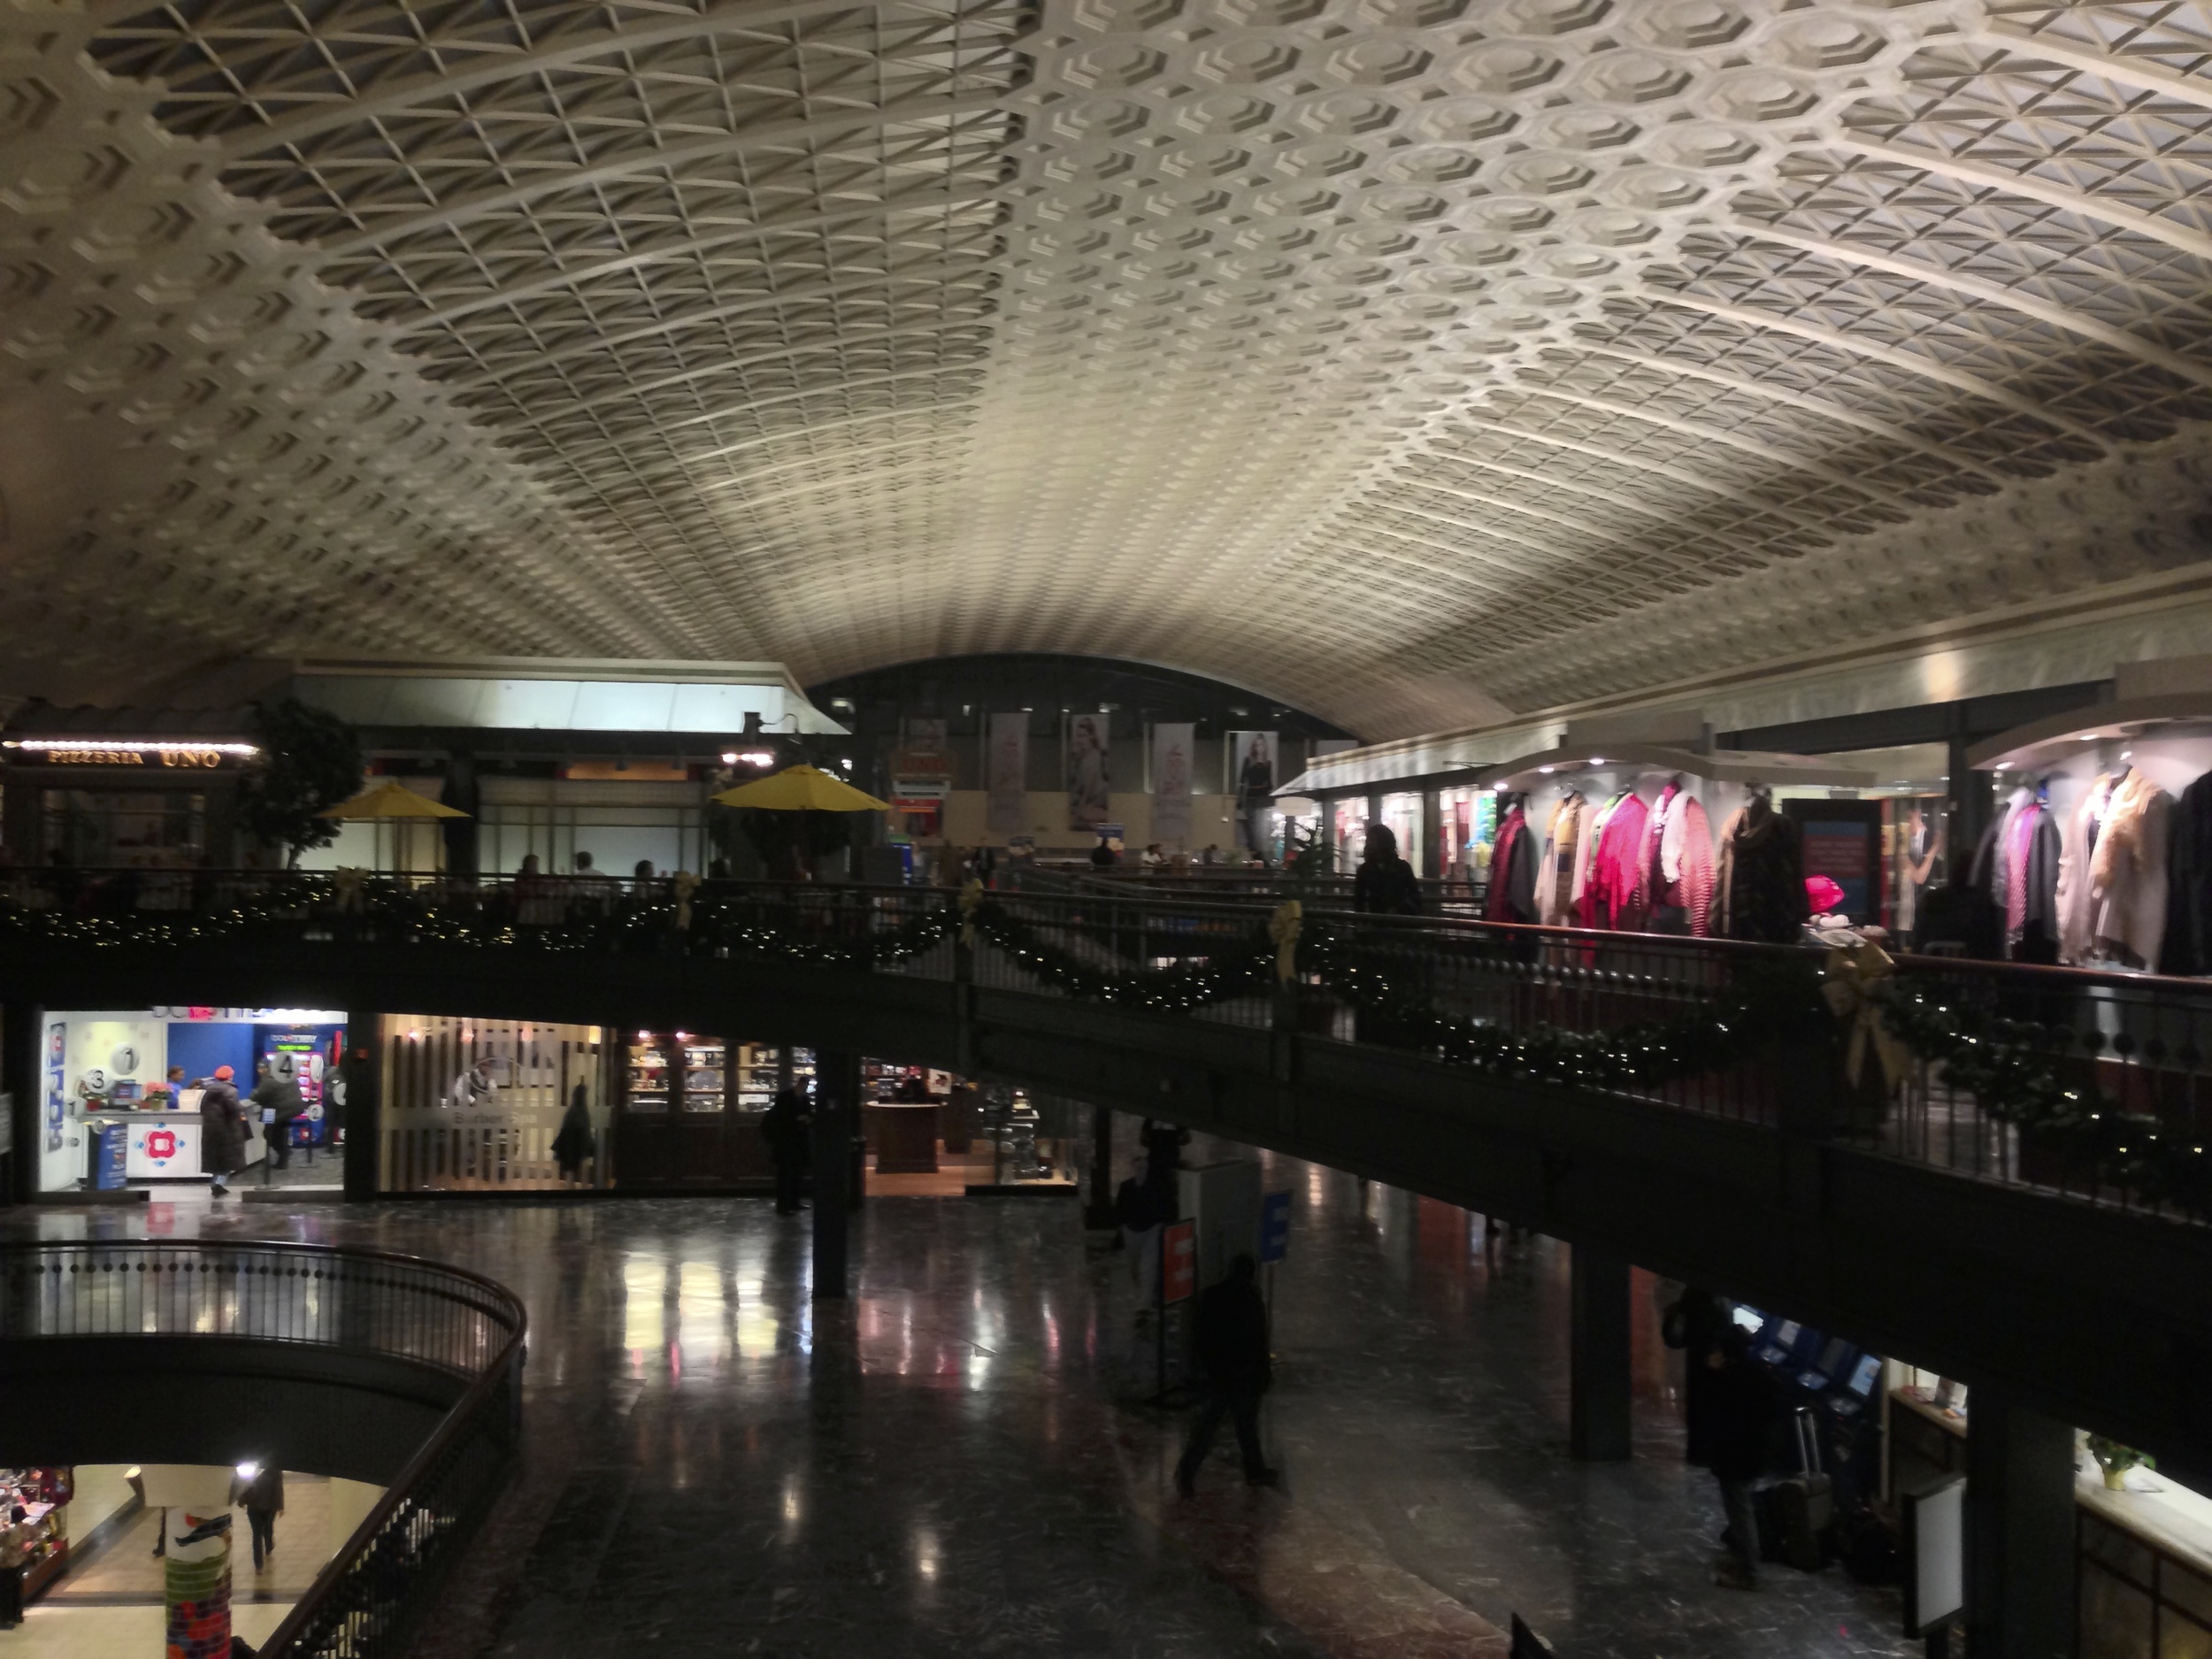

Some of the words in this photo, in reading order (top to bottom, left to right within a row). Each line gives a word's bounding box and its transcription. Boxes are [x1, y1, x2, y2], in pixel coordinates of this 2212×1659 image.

[47, 750, 144, 764] PIZZERIA
[160, 750, 221, 767] UNO
[91, 1070, 104, 1089] 3
